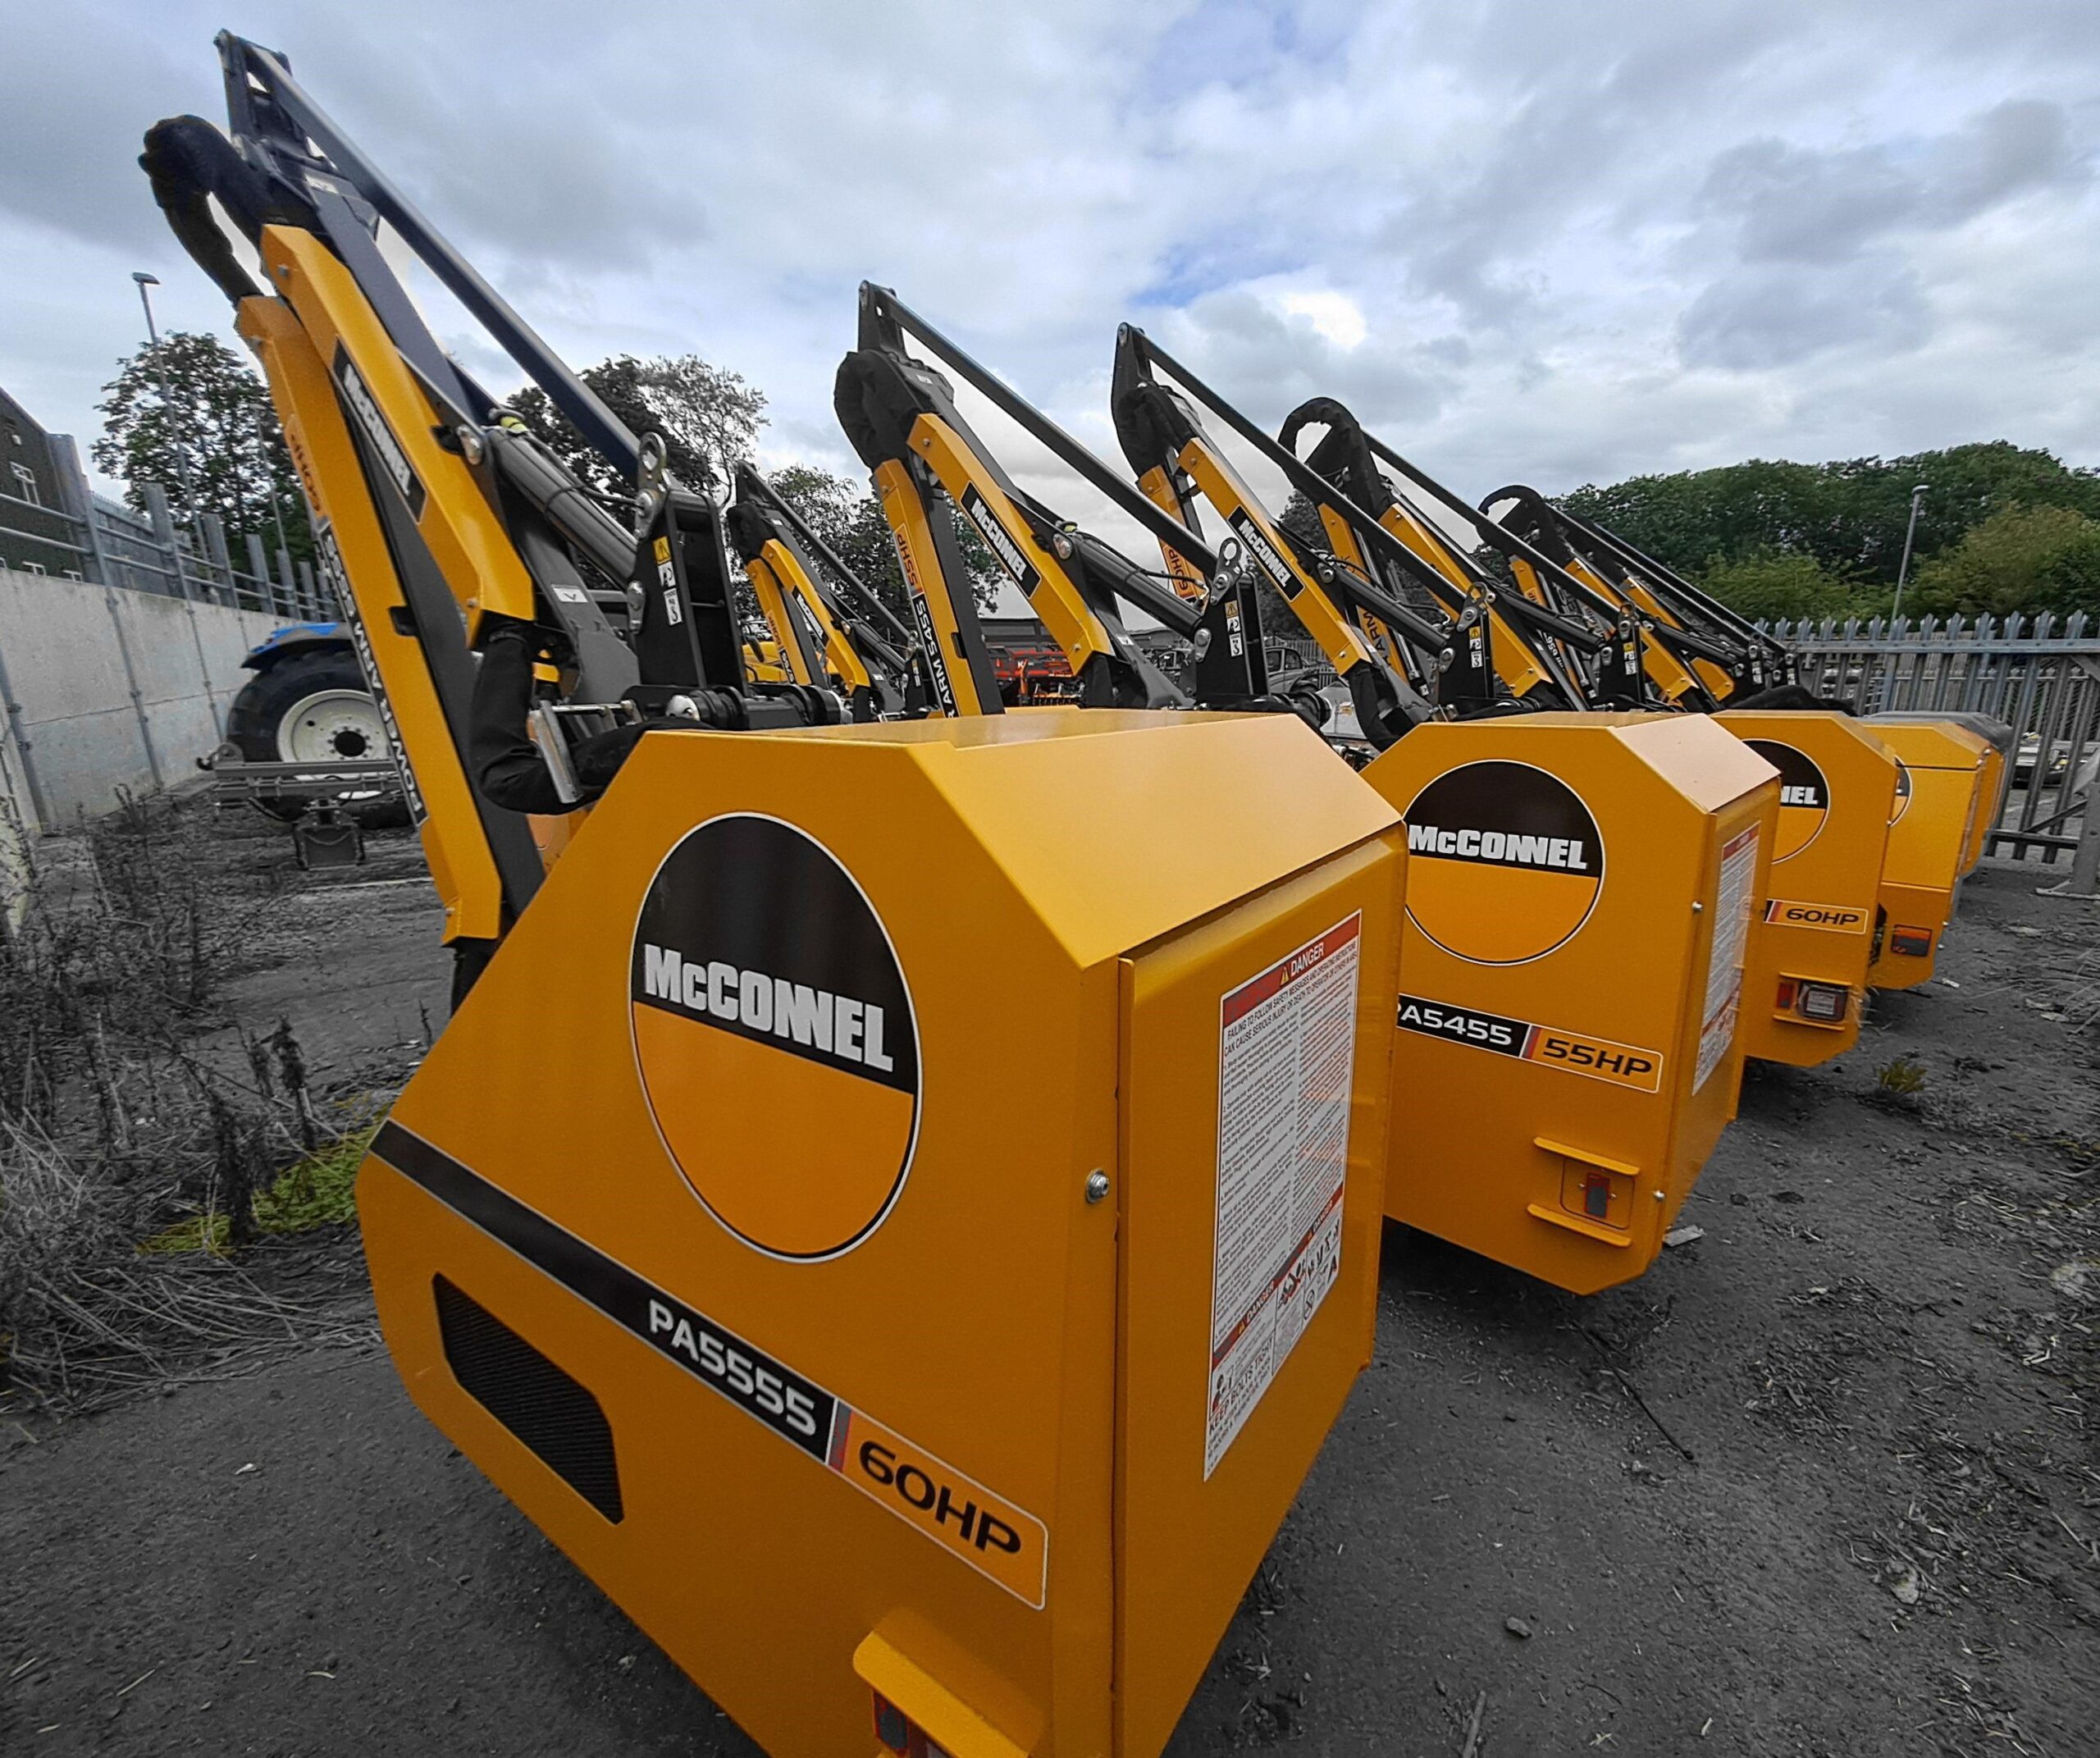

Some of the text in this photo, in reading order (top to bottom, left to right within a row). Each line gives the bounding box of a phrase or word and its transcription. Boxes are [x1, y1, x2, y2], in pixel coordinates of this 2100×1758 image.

[897, 533, 919, 587] 55HP
[916, 600, 939, 657] 5455
[354, 625, 382, 690] ARM
[934, 657, 954, 705] ARM
[1408, 824, 1588, 870] McCONNEL
[1786, 907, 1860, 926] 60HP
[1290, 942, 1324, 976] DANGER
[643, 943, 894, 1073] McCONNEL
[1542, 1038, 1652, 1078] 55HP
[1245, 1279, 1275, 1325] DANGER
[648, 1298, 1022, 1556] PA5555 60HP
